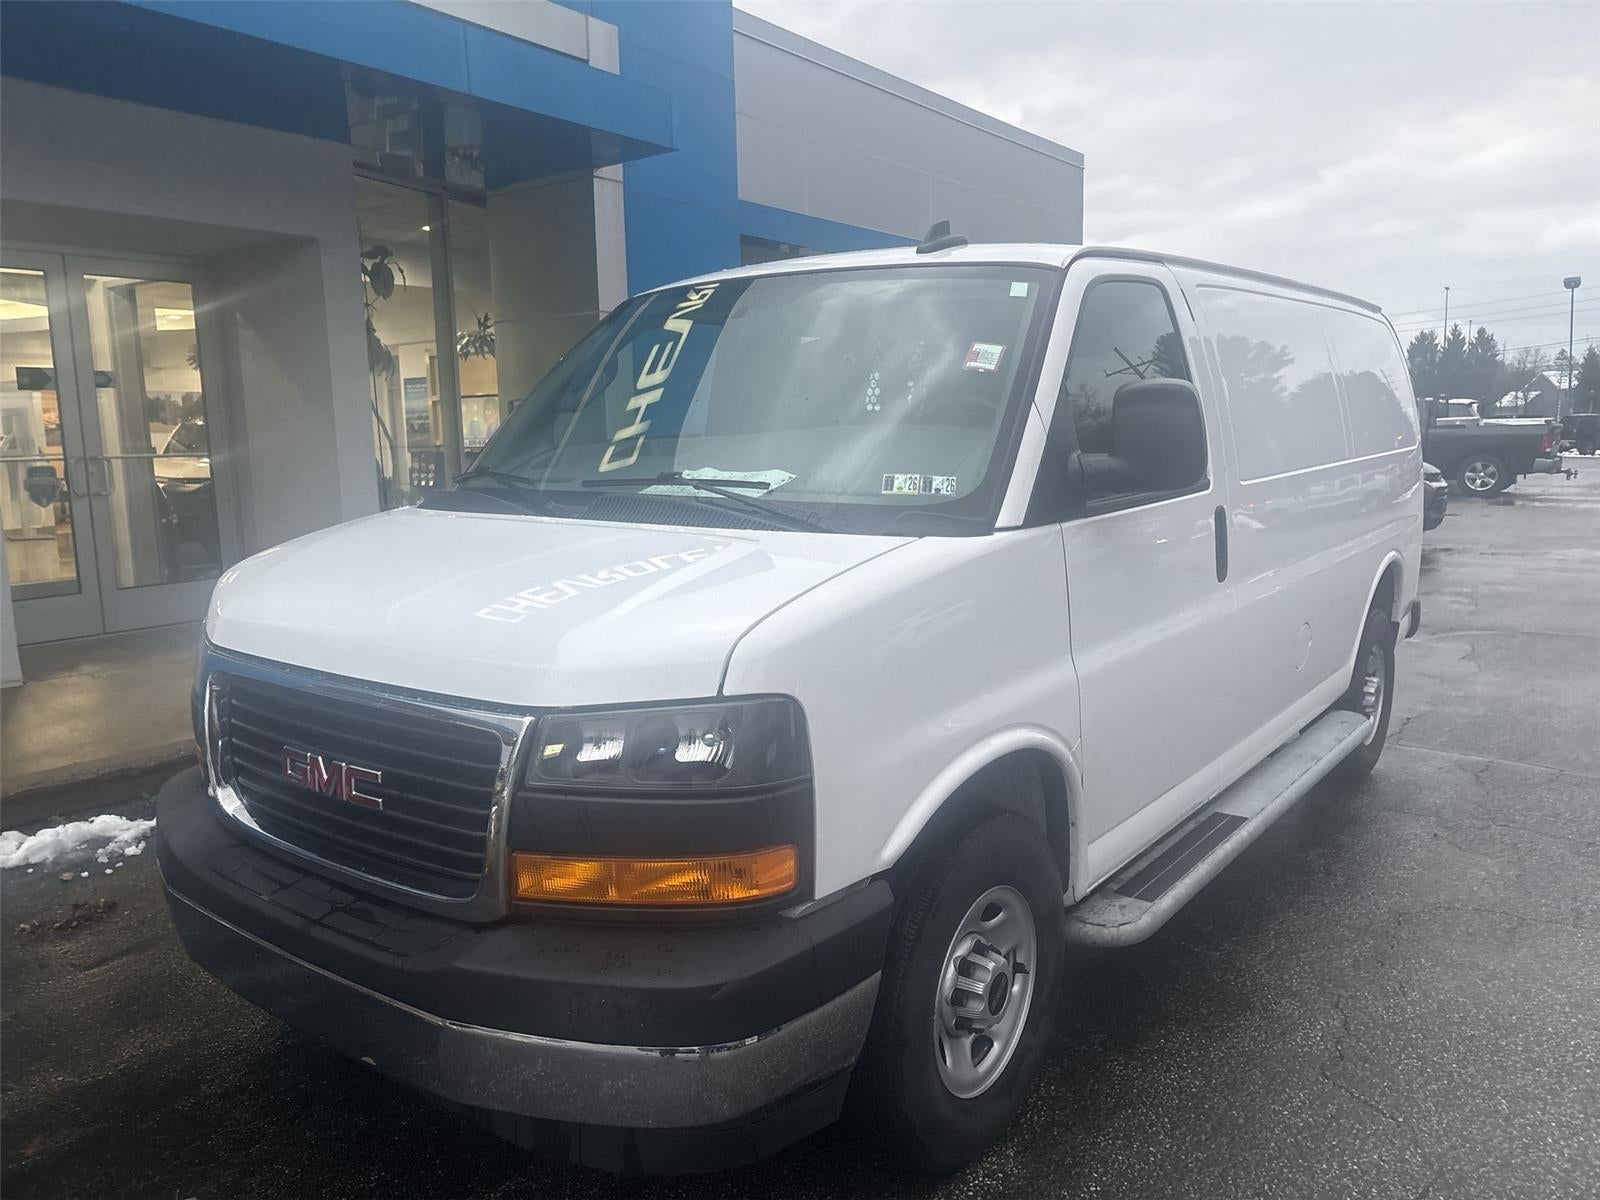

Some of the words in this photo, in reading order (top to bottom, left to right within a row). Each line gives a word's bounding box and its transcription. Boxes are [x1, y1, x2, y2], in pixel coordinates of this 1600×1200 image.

[908, 476, 918, 491] 26
[945, 478, 955, 493] 26
[281, 745, 383, 811] GMC
